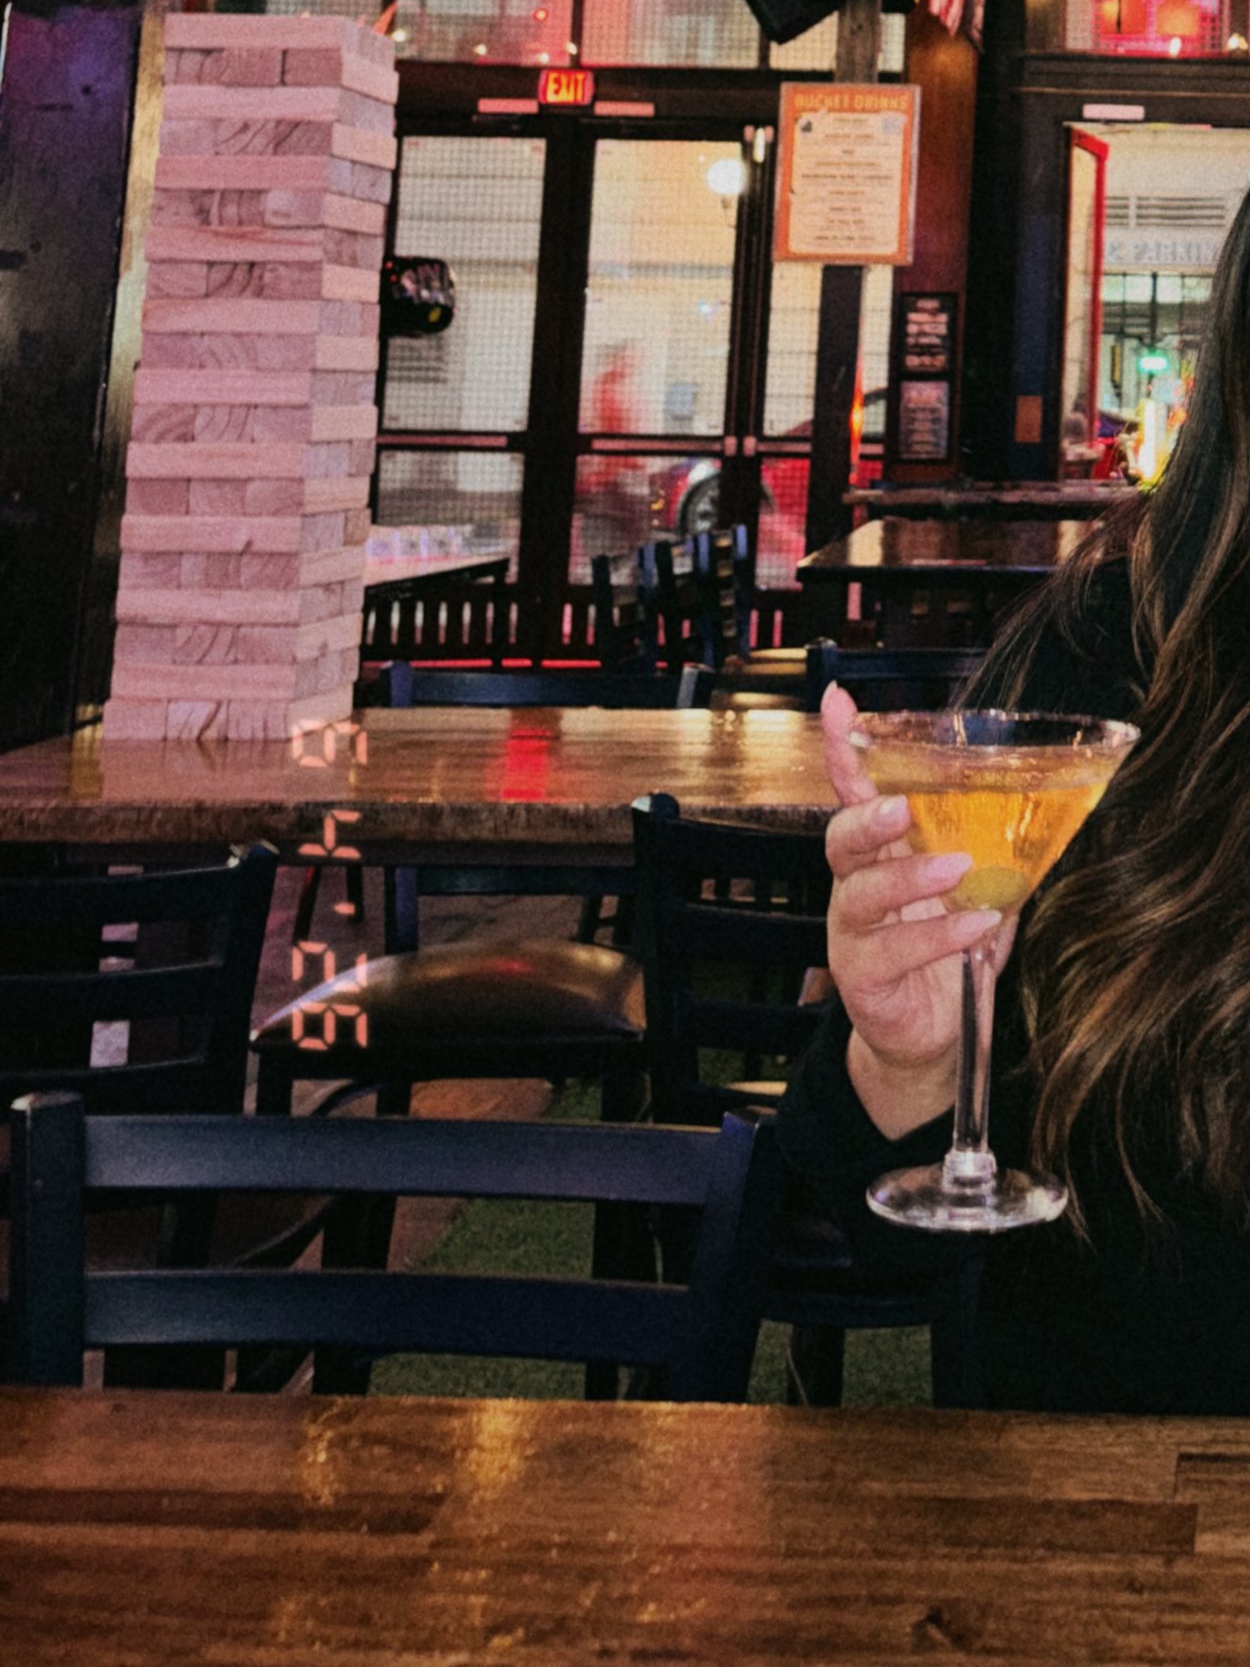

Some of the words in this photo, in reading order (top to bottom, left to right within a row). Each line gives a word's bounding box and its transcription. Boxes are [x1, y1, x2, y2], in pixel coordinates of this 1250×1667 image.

[547, 72, 586, 103] EXIT
[794, 93, 849, 109] BUCKET
[855, 93, 908, 110] DRINKS
[1132, 240, 1217, 262] PARKIN
